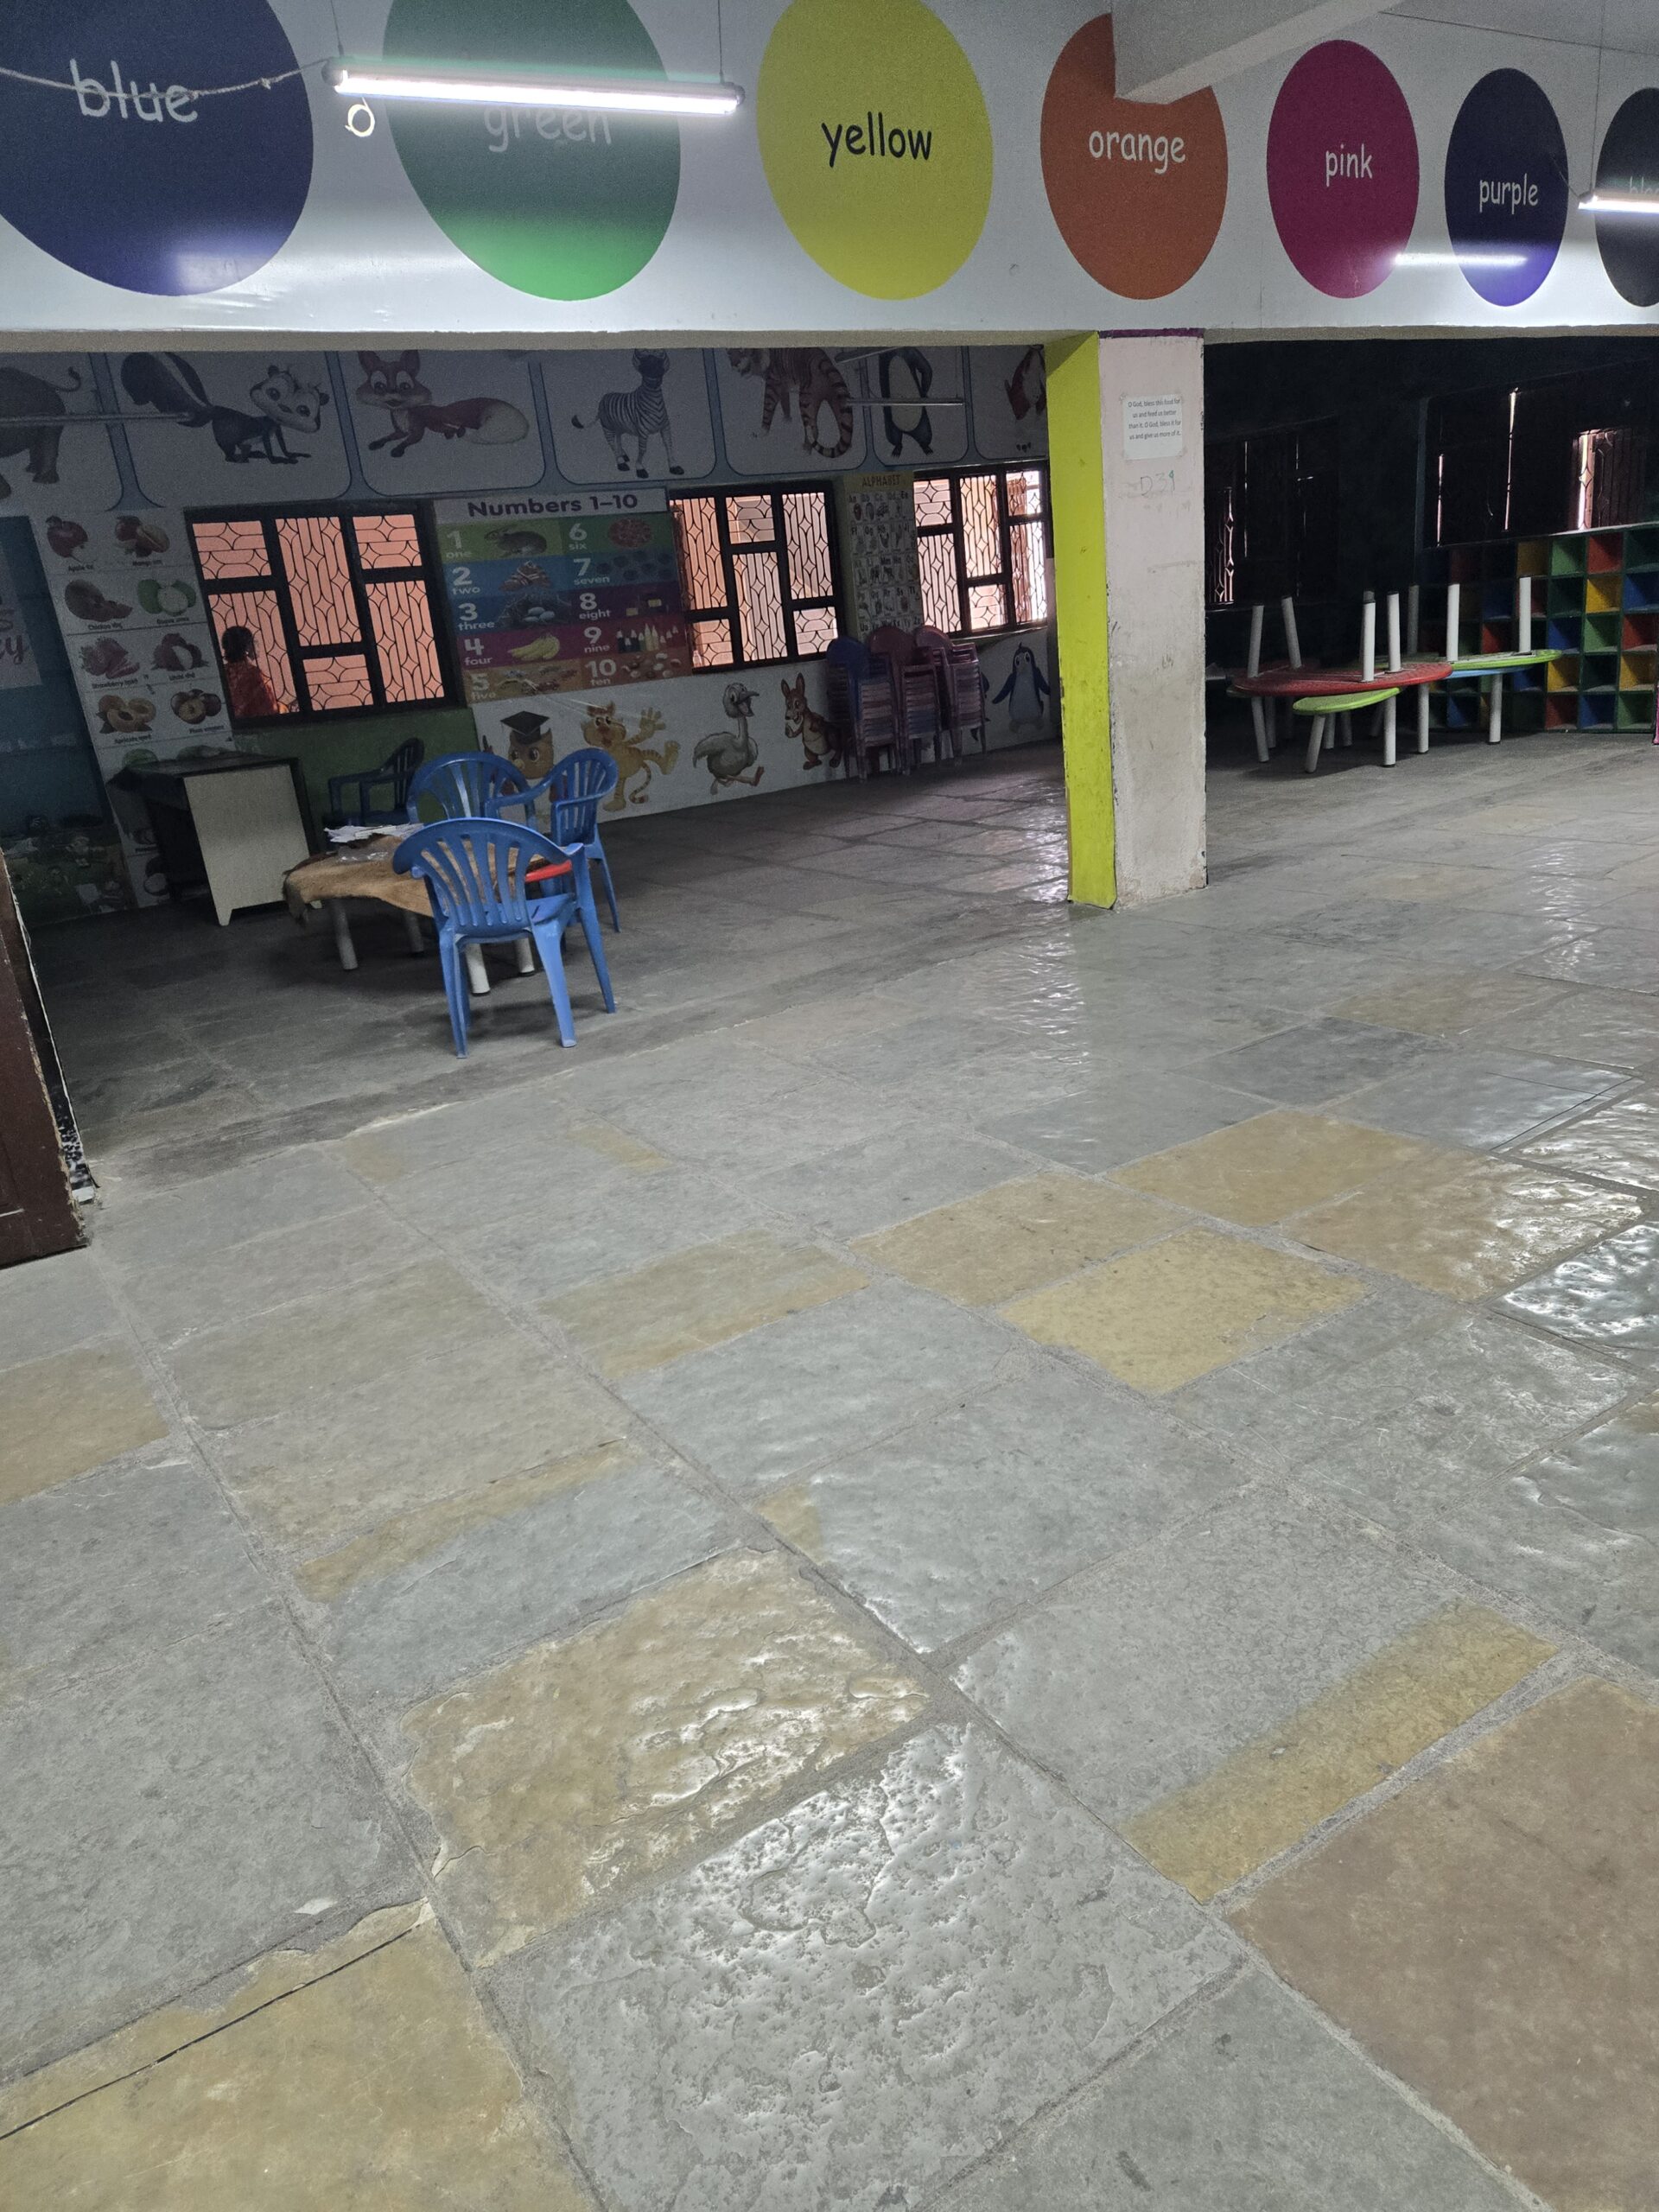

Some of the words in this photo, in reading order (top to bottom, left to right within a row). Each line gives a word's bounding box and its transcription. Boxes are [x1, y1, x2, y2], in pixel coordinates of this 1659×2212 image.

[69, 58, 199, 124] blue
[484, 105, 613, 153] green
[820, 111, 933, 168] yellow
[1088, 128, 1187, 175] orange
[1325, 143, 1374, 188] pink
[1478, 172, 1539, 215] purple
[862, 475, 901, 487] ALPHABET
[467, 498, 582, 518] Numbers
[446, 530, 462, 550] 1
[569, 523, 588, 542] 6
[445, 550, 472, 559] one
[569, 542, 587, 551] six
[573, 558, 592, 576] 7
[452, 566, 473, 587] 2
[574, 575, 610, 585] seven
[451, 585, 480, 594] two
[579, 592, 598, 611] 8
[458, 603, 479, 622] 3
[579, 609, 612, 620] eight
[458, 620, 495, 631] three
[583, 626, 601, 645] 9
[464, 638, 485, 657] 4
[584, 643, 610, 653] nine
[464, 656, 493, 665] four
[586, 659, 617, 677] 10
[471, 673, 490, 691] 5
[589, 677, 612, 686] ten
[470, 690, 497, 700] five
